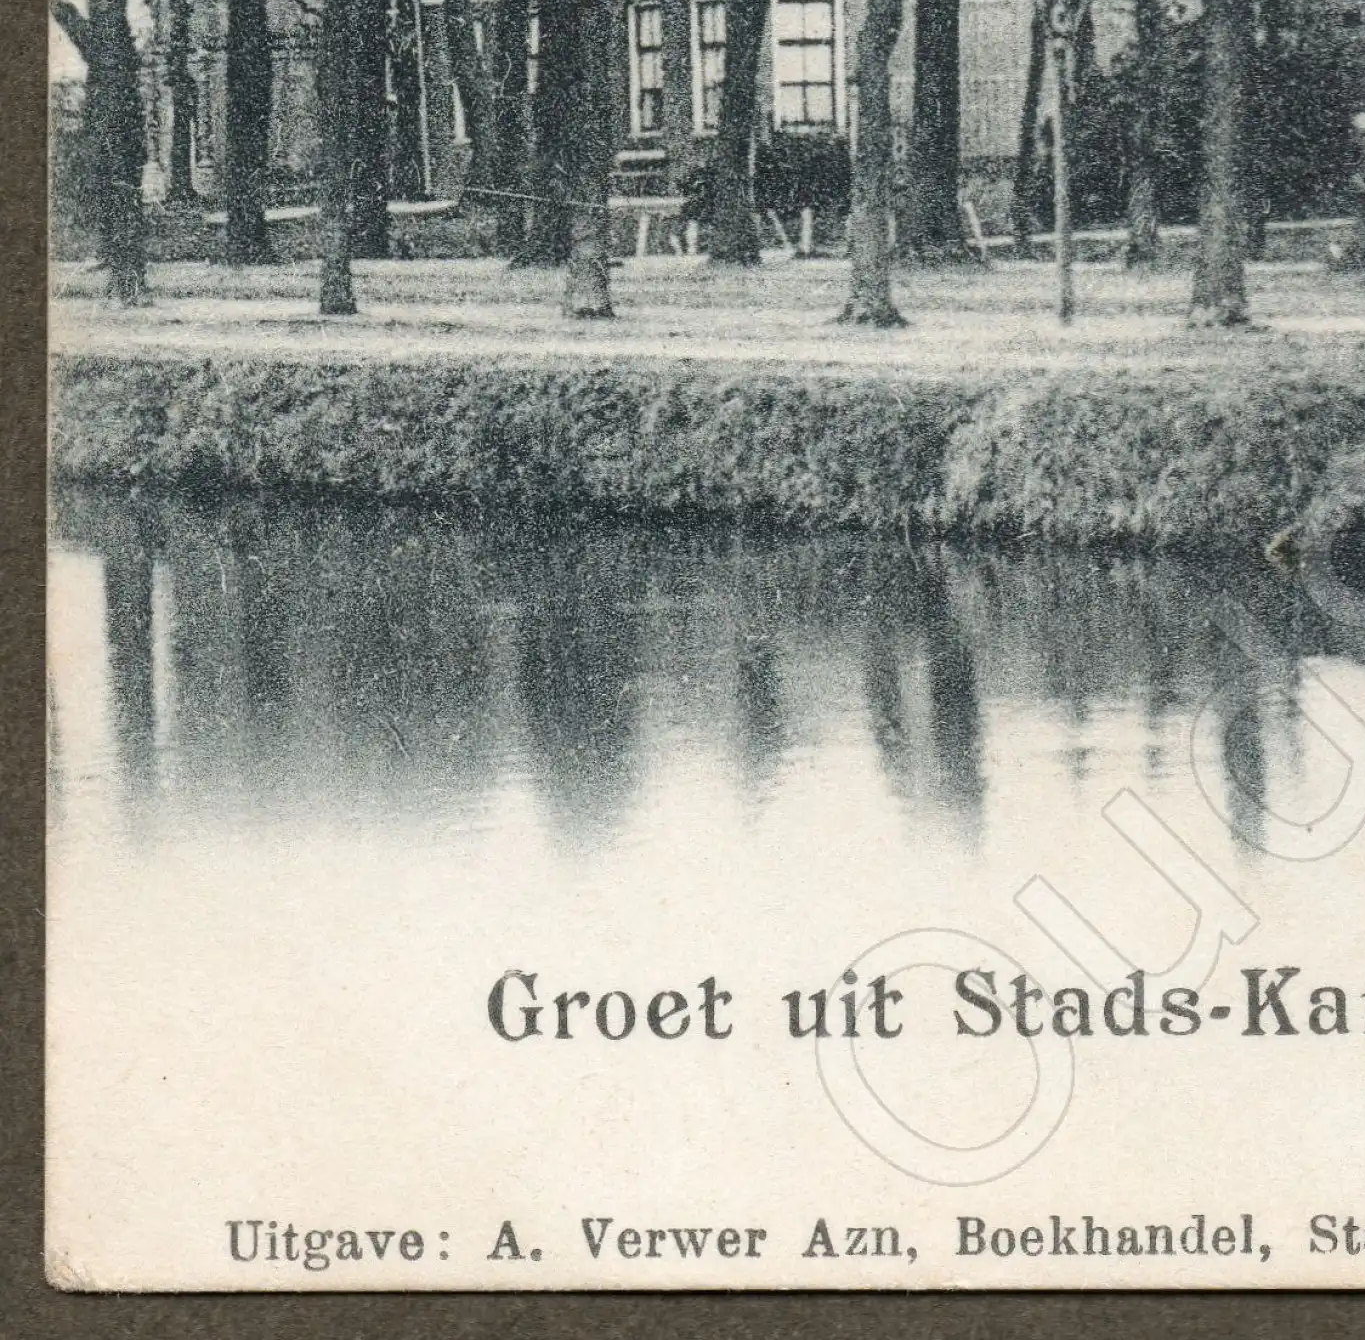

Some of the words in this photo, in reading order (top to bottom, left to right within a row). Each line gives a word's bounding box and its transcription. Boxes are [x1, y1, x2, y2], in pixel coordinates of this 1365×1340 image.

[486, 970, 734, 1042] Groet
[782, 969, 904, 1039] uit
[226, 1219, 451, 1272] Uitgave:
[486, 1220, 543, 1262] A.
[581, 1217, 768, 1259] Verwer
[801, 1219, 919, 1261] Azn,
[955, 1213, 1272, 1263] Boekhandel,
